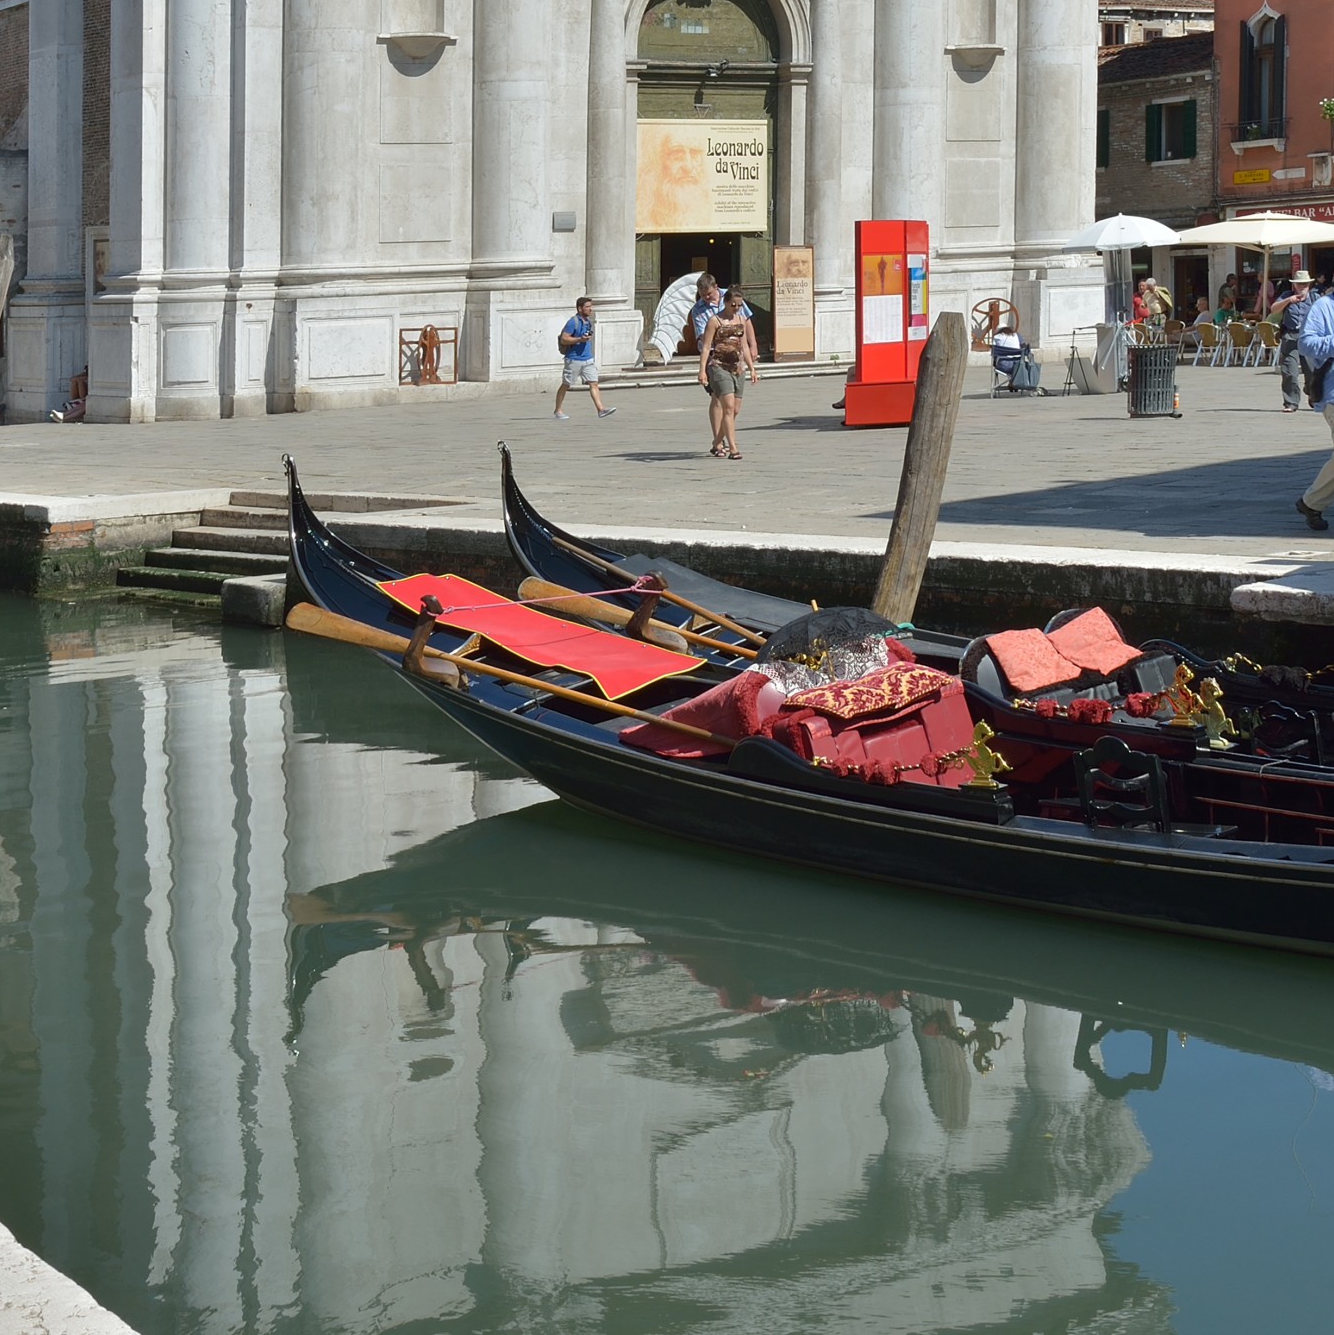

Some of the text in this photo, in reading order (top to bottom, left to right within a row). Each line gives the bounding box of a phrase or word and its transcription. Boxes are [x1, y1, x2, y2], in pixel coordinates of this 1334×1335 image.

[707, 138, 764, 156] Leonardo
[715, 158, 759, 180] da Vinci
[1294, 207, 1316, 217] BAR
